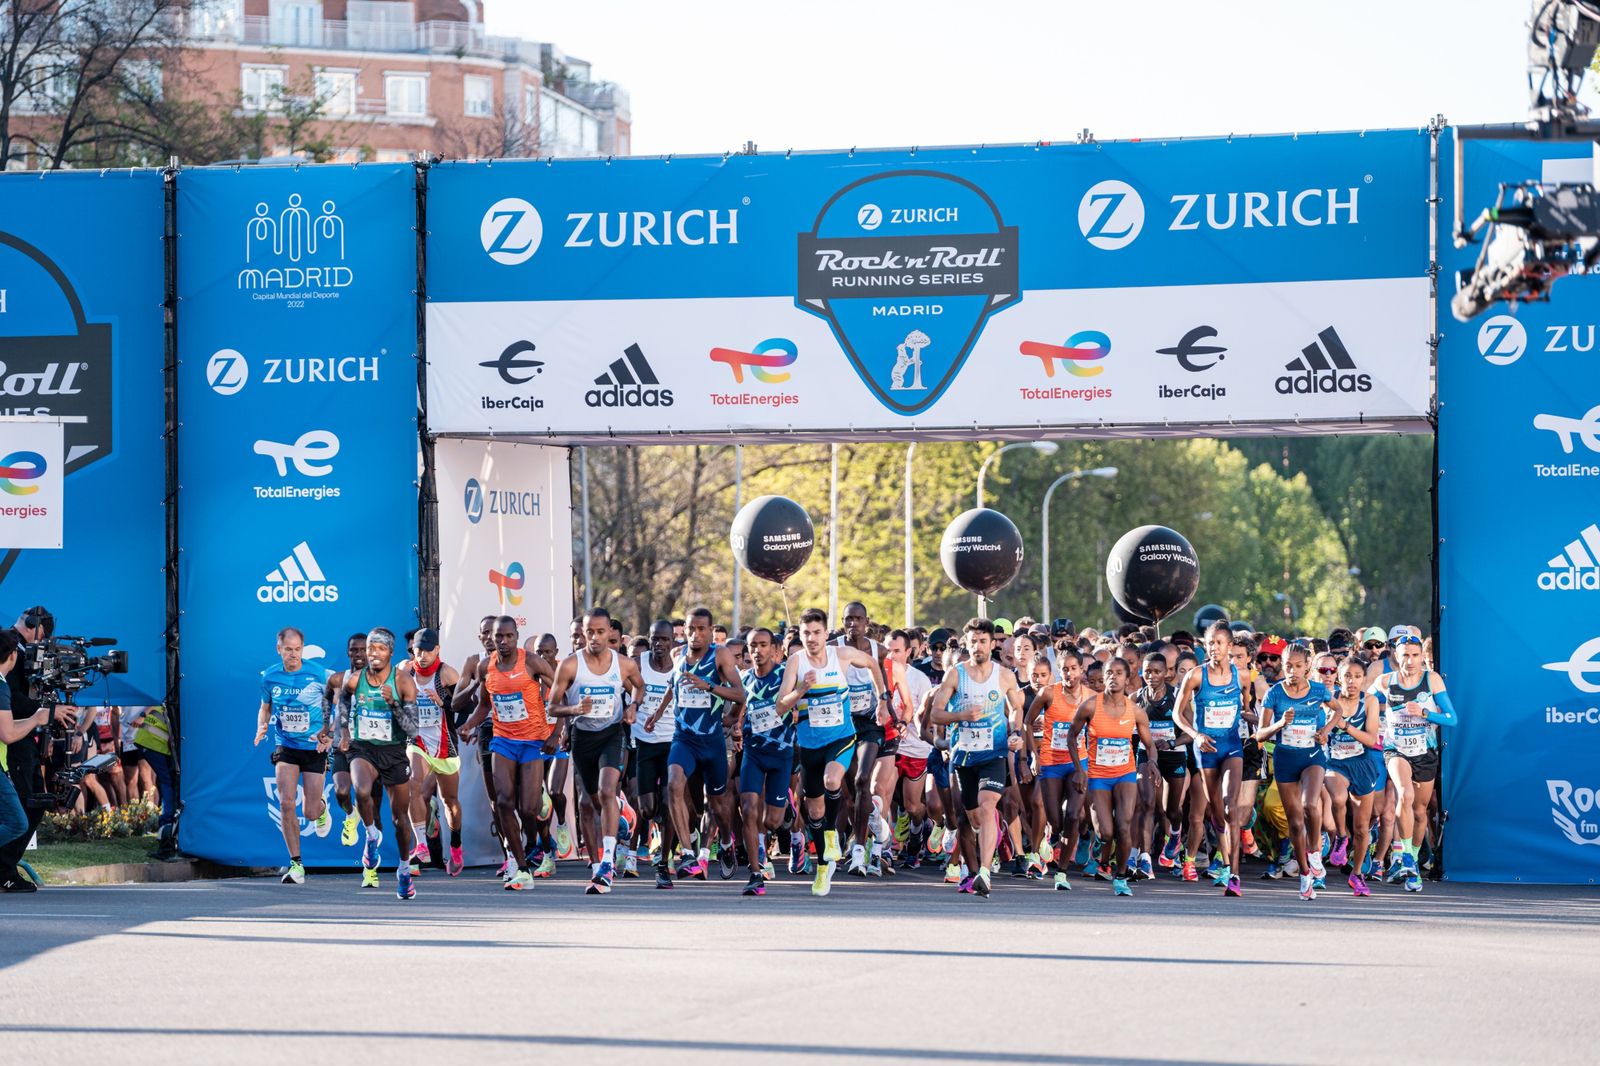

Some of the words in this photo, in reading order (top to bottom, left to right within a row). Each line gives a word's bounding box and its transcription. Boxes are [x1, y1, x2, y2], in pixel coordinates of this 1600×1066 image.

[890, 207, 959, 224] ZURICH
[1168, 187, 1360, 231] ZURICH
[563, 208, 739, 248] ZURICH
[815, 249, 903, 271] Rock
[929, 246, 1002, 269] Roll
[238, 266, 353, 289] MADRID
[832, 274, 914, 287] RUNNING
[919, 272, 984, 285] SERIES
[252, 292, 275, 301] Capital
[276, 292, 301, 300] Mundial
[301, 291, 312, 299] del
[313, 291, 340, 300] Deporte
[287, 300, 304, 308] 2022
[873, 304, 944, 317] MADRID
[1544, 325, 1595, 352] ZU
[262, 356, 379, 384] ZURICH
[1274, 369, 1372, 394] adidas
[585, 383, 674, 408] adidas
[710, 391, 799, 407] TotalEnergies
[1020, 386, 1112, 401] TotalEnergies
[1158, 383, 1226, 400] iberCaja
[481, 395, 544, 412] iberCaja
[253, 486, 341, 500] TotalEnergies
[489, 489, 541, 516] ZURICH
[763, 533, 801, 543] SAMSUNG
[951, 535, 983, 544] AMSUNG
[763, 544, 792, 552] Galaxy
[949, 545, 972, 553] alaxy
[1139, 543, 1182, 553] SAMSUNG
[1139, 553, 1172, 562] Galaxy
[1537, 566, 1600, 590] adid
[256, 580, 338, 603] adidas
[285, 714, 302, 722] 3032
[1545, 706, 1600, 724] iberC
[369, 720, 379, 729] 35
[971, 730, 980, 739] 34
[1404, 737, 1417, 746] 150
[1546, 780, 1600, 819] Ro
[1580, 819, 1598, 834] fm
